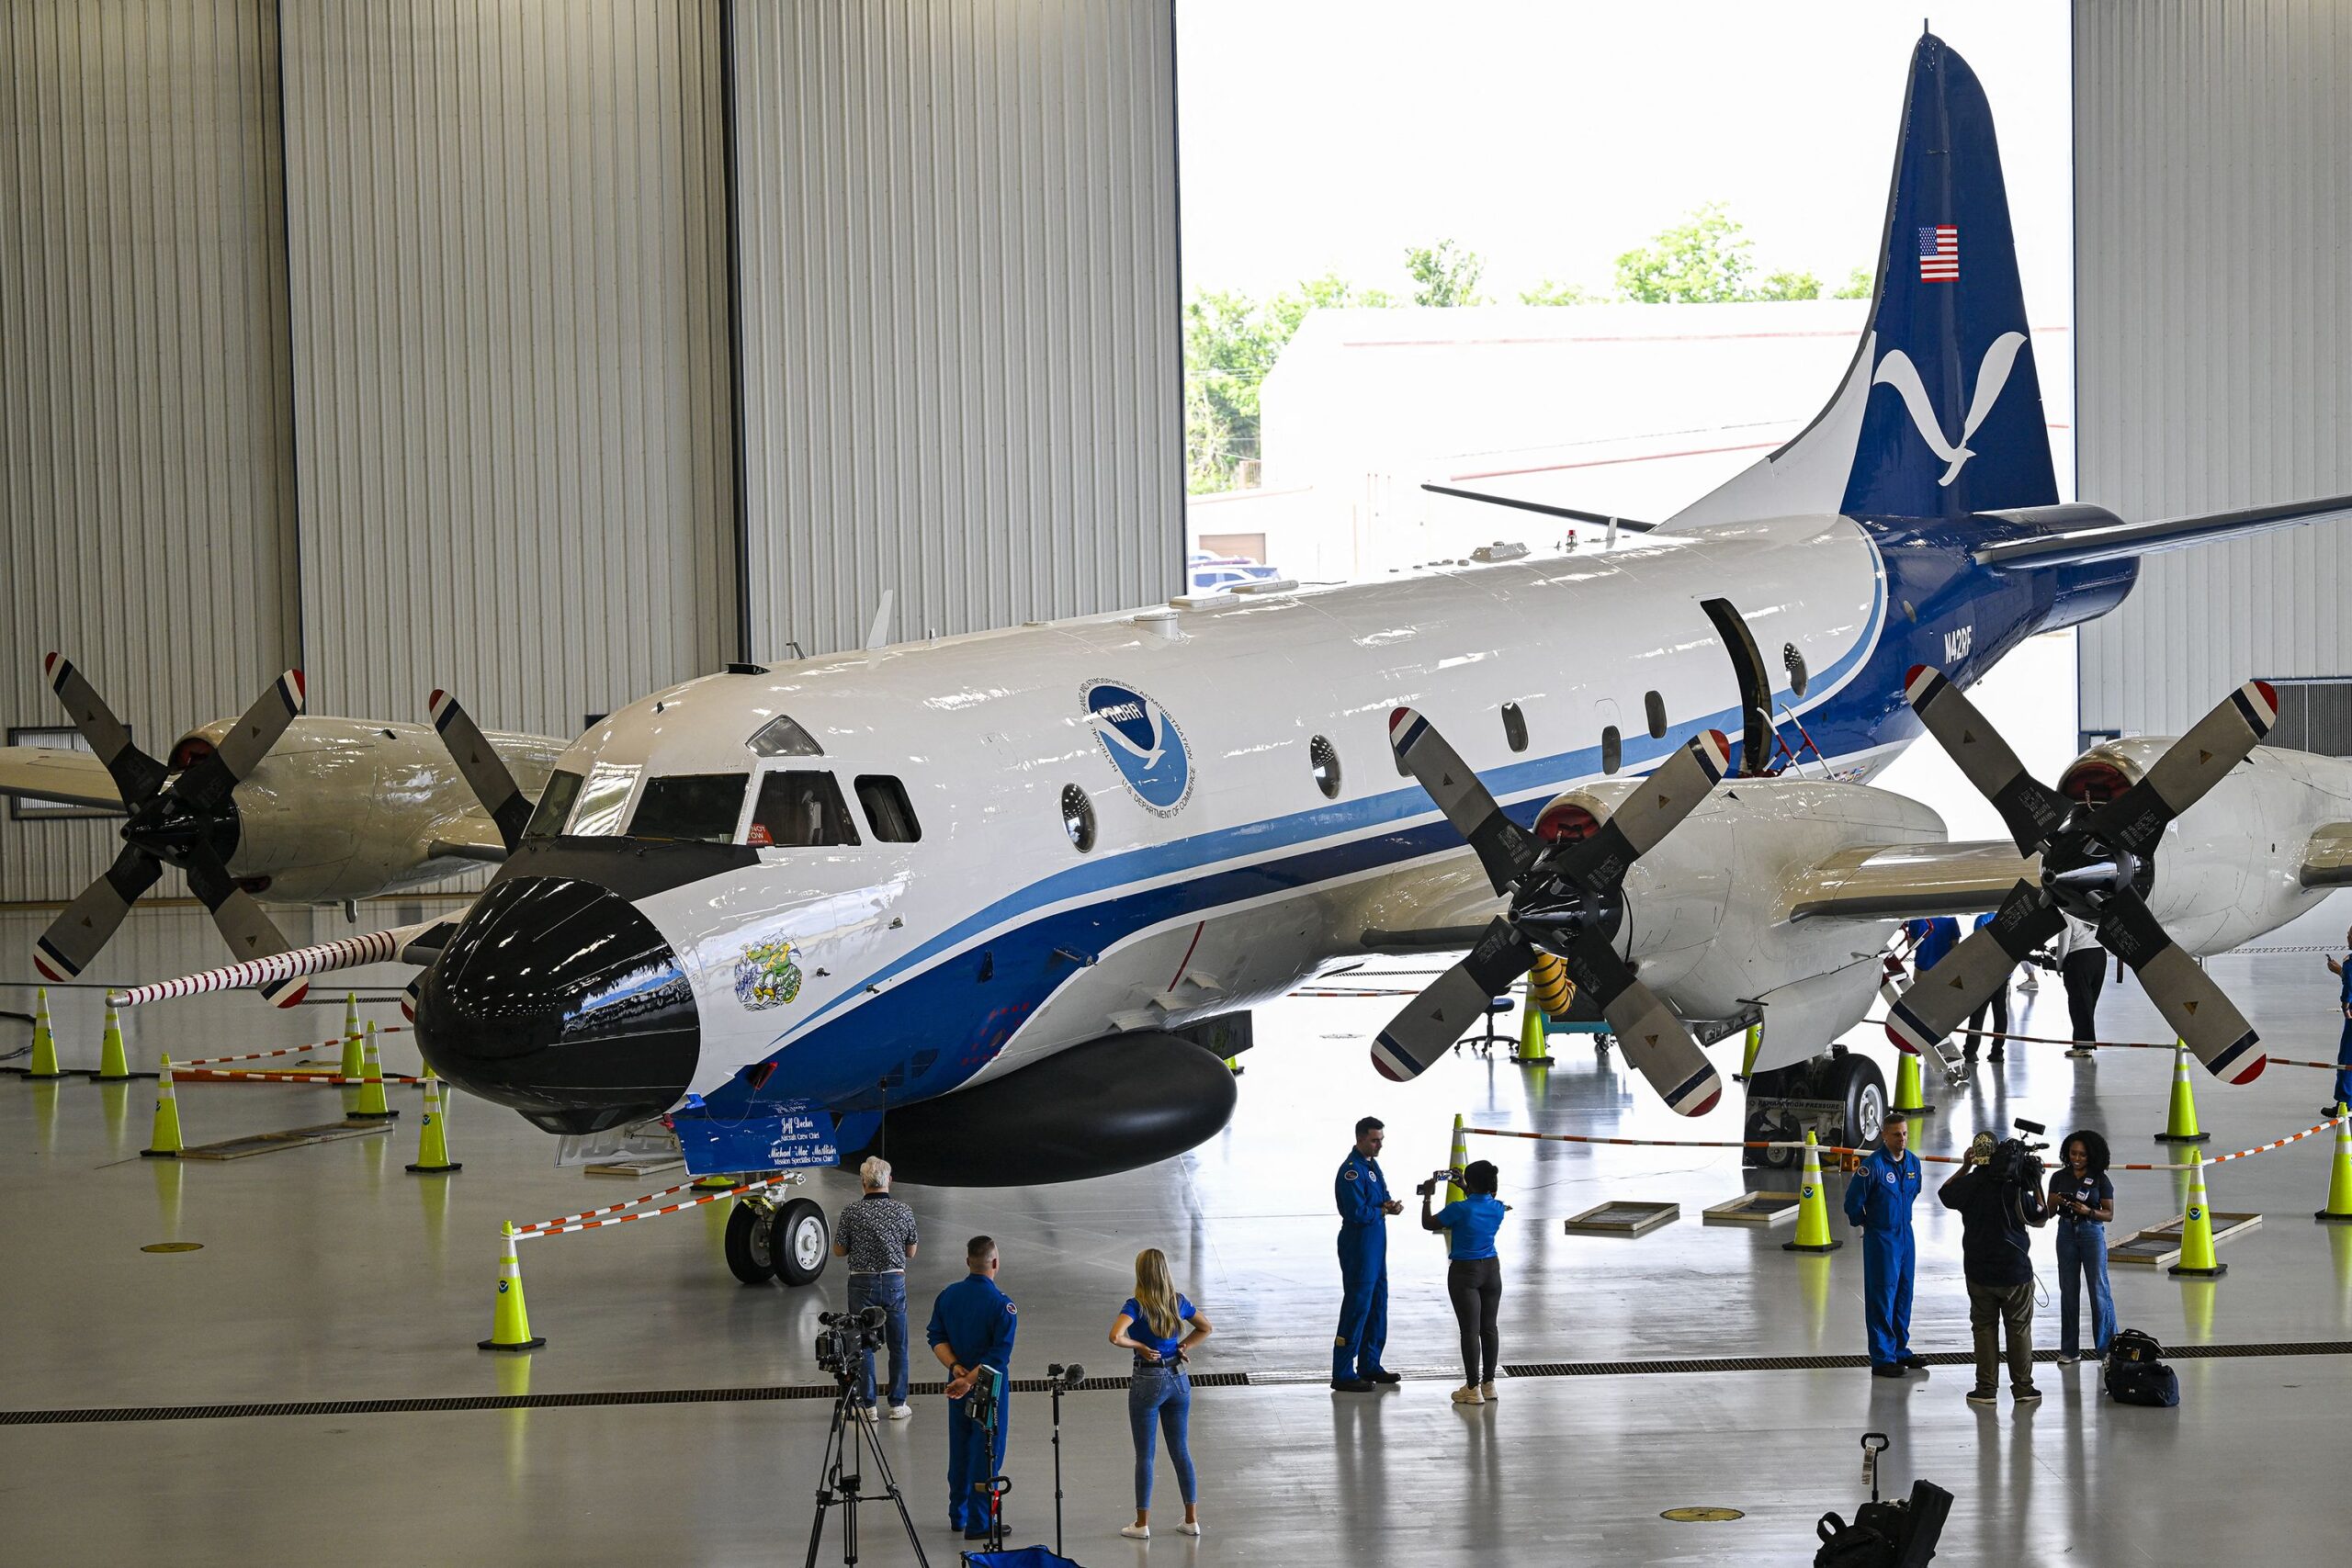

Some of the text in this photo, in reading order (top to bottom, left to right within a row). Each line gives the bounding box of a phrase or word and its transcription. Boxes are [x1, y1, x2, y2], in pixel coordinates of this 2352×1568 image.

[1944, 626, 1972, 664] N42RF
[1079, 682, 1090, 694] AND
[1087, 677, 1137, 694] ATMOSPHERIC
[1139, 690, 1193, 761] ADMINISTRATION
[1091, 727, 1118, 773] NATIONAL
[1133, 795, 1171, 819] DEPARTMENT
[1171, 805, 1181, 818] OF
[1179, 766, 1195, 811] COMMERCE
[781, 1117, 794, 1134] Jeff
[768, 1145, 792, 1159] Michael
